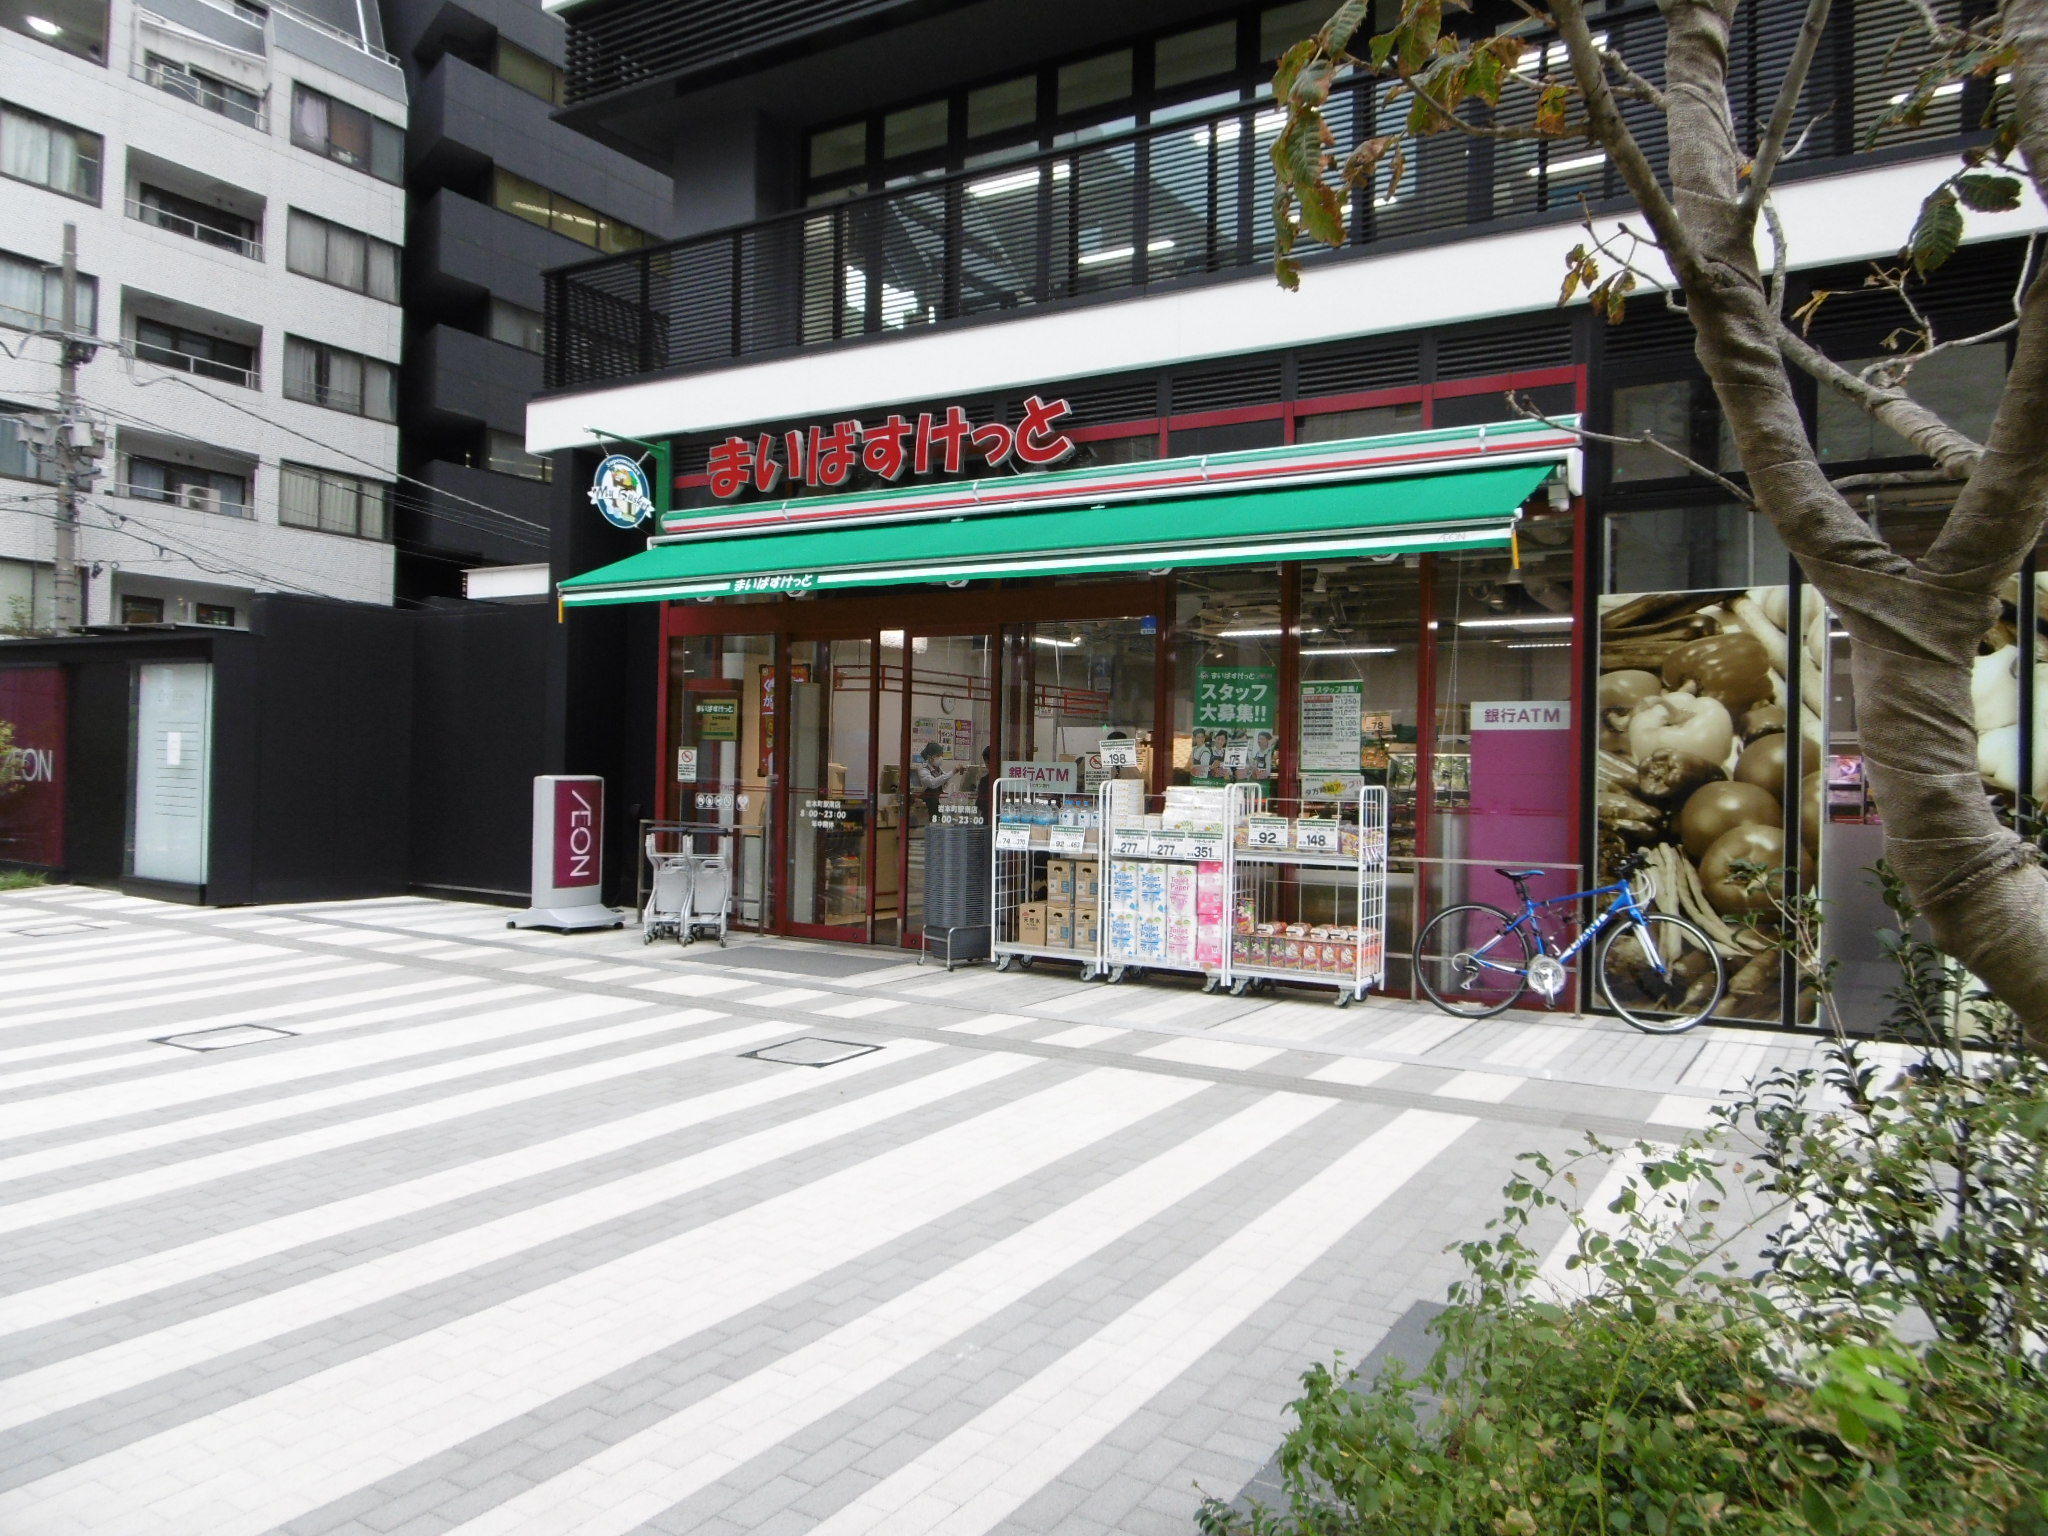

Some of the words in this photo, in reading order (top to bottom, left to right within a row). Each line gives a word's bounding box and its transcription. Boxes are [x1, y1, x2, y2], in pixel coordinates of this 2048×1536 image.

[706, 396, 1075, 498] まいばすけっと
[733, 574, 813, 592] まいばすけっと
[1211, 672, 1255, 680] まいばすけっと
[1201, 683, 1268, 702] スタッフ
[1484, 708, 1561, 723] 銀行ATM
[1371, 721, 1384, 730] 78
[1109, 753, 1127, 764] 198
[1008, 766, 1070, 782] 銀行ATM
[938, 805, 978, 814] 岩本町駅南店
[569, 789, 592, 877] AEON
[1259, 832, 1277, 844] 92
[1306, 834, 1326, 847] 148
[1120, 842, 1138, 853] 277
[1157, 844, 1175, 856] 277
[1194, 846, 1212, 858] 351
[1114, 872, 1132, 880] Toilet
[1141, 874, 1160, 882] Toilet
[1114, 879, 1134, 887] Paper
[1142, 881, 1161, 889] Paper
[1170, 883, 1189, 891] Paper
[1112, 920, 1130, 928] Toilet
[1140, 923, 1159, 932] Toilet
[1112, 927, 1131, 935] Paper
[1140, 930, 1160, 939] Paper
[1169, 926, 1188, 934] Toilet
[1169, 933, 1189, 941] Paper
